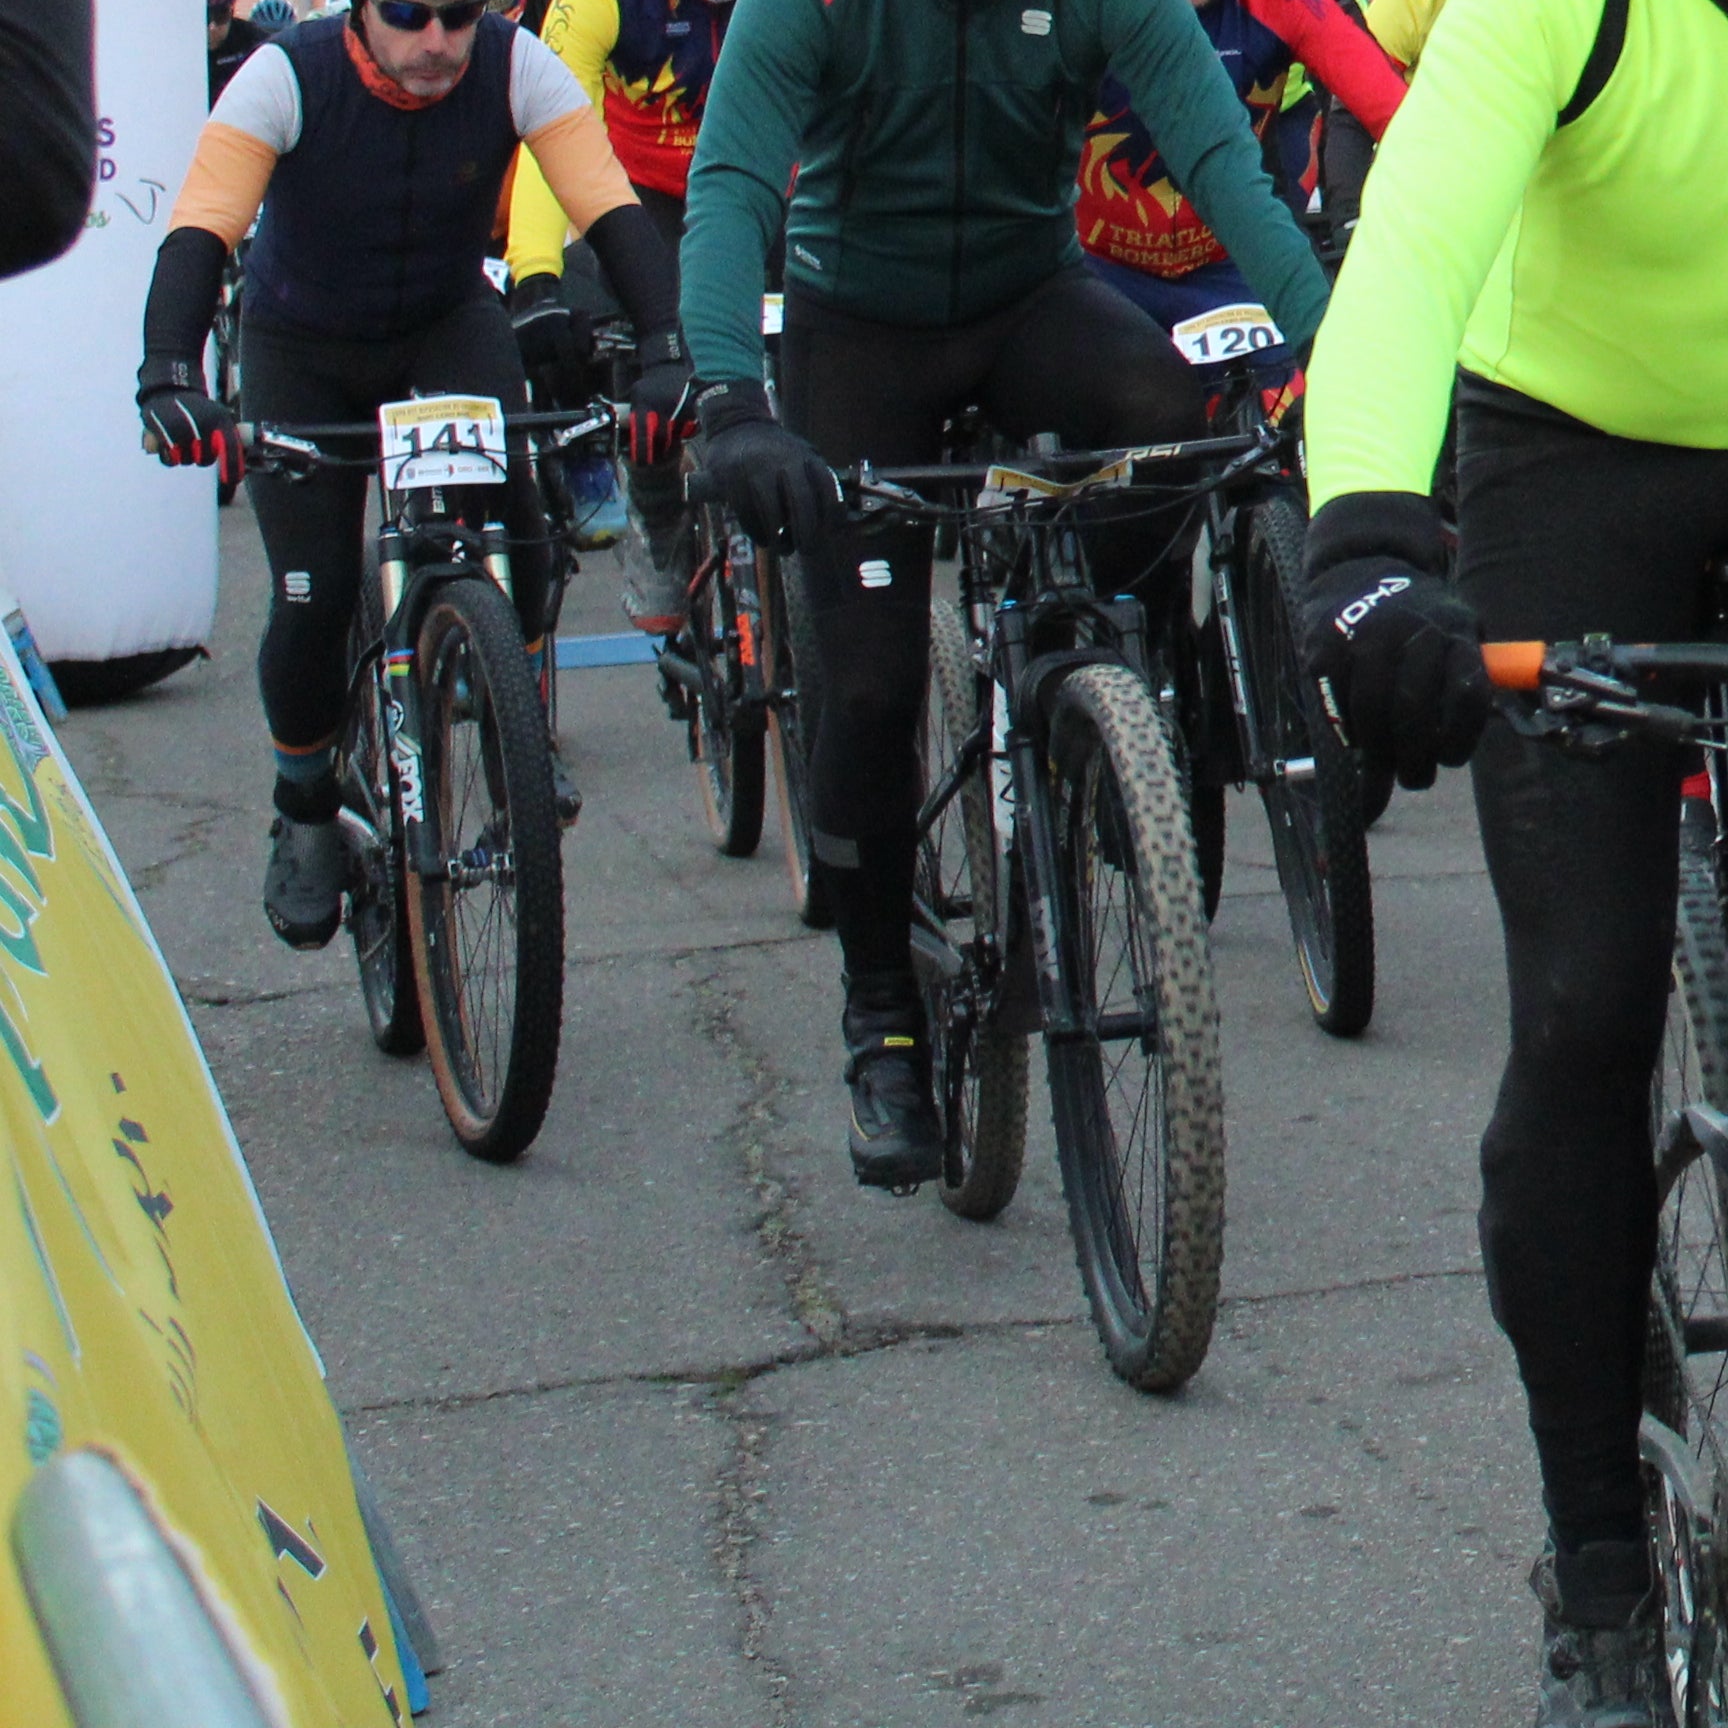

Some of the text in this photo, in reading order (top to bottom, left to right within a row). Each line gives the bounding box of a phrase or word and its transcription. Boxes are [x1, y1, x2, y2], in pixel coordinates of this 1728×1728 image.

[1110, 224, 1212, 249] TRIATLO
[1110, 242, 1217, 265] BOMBERO
[1192, 326, 1276, 357] 120
[402, 422, 486, 459] 141
